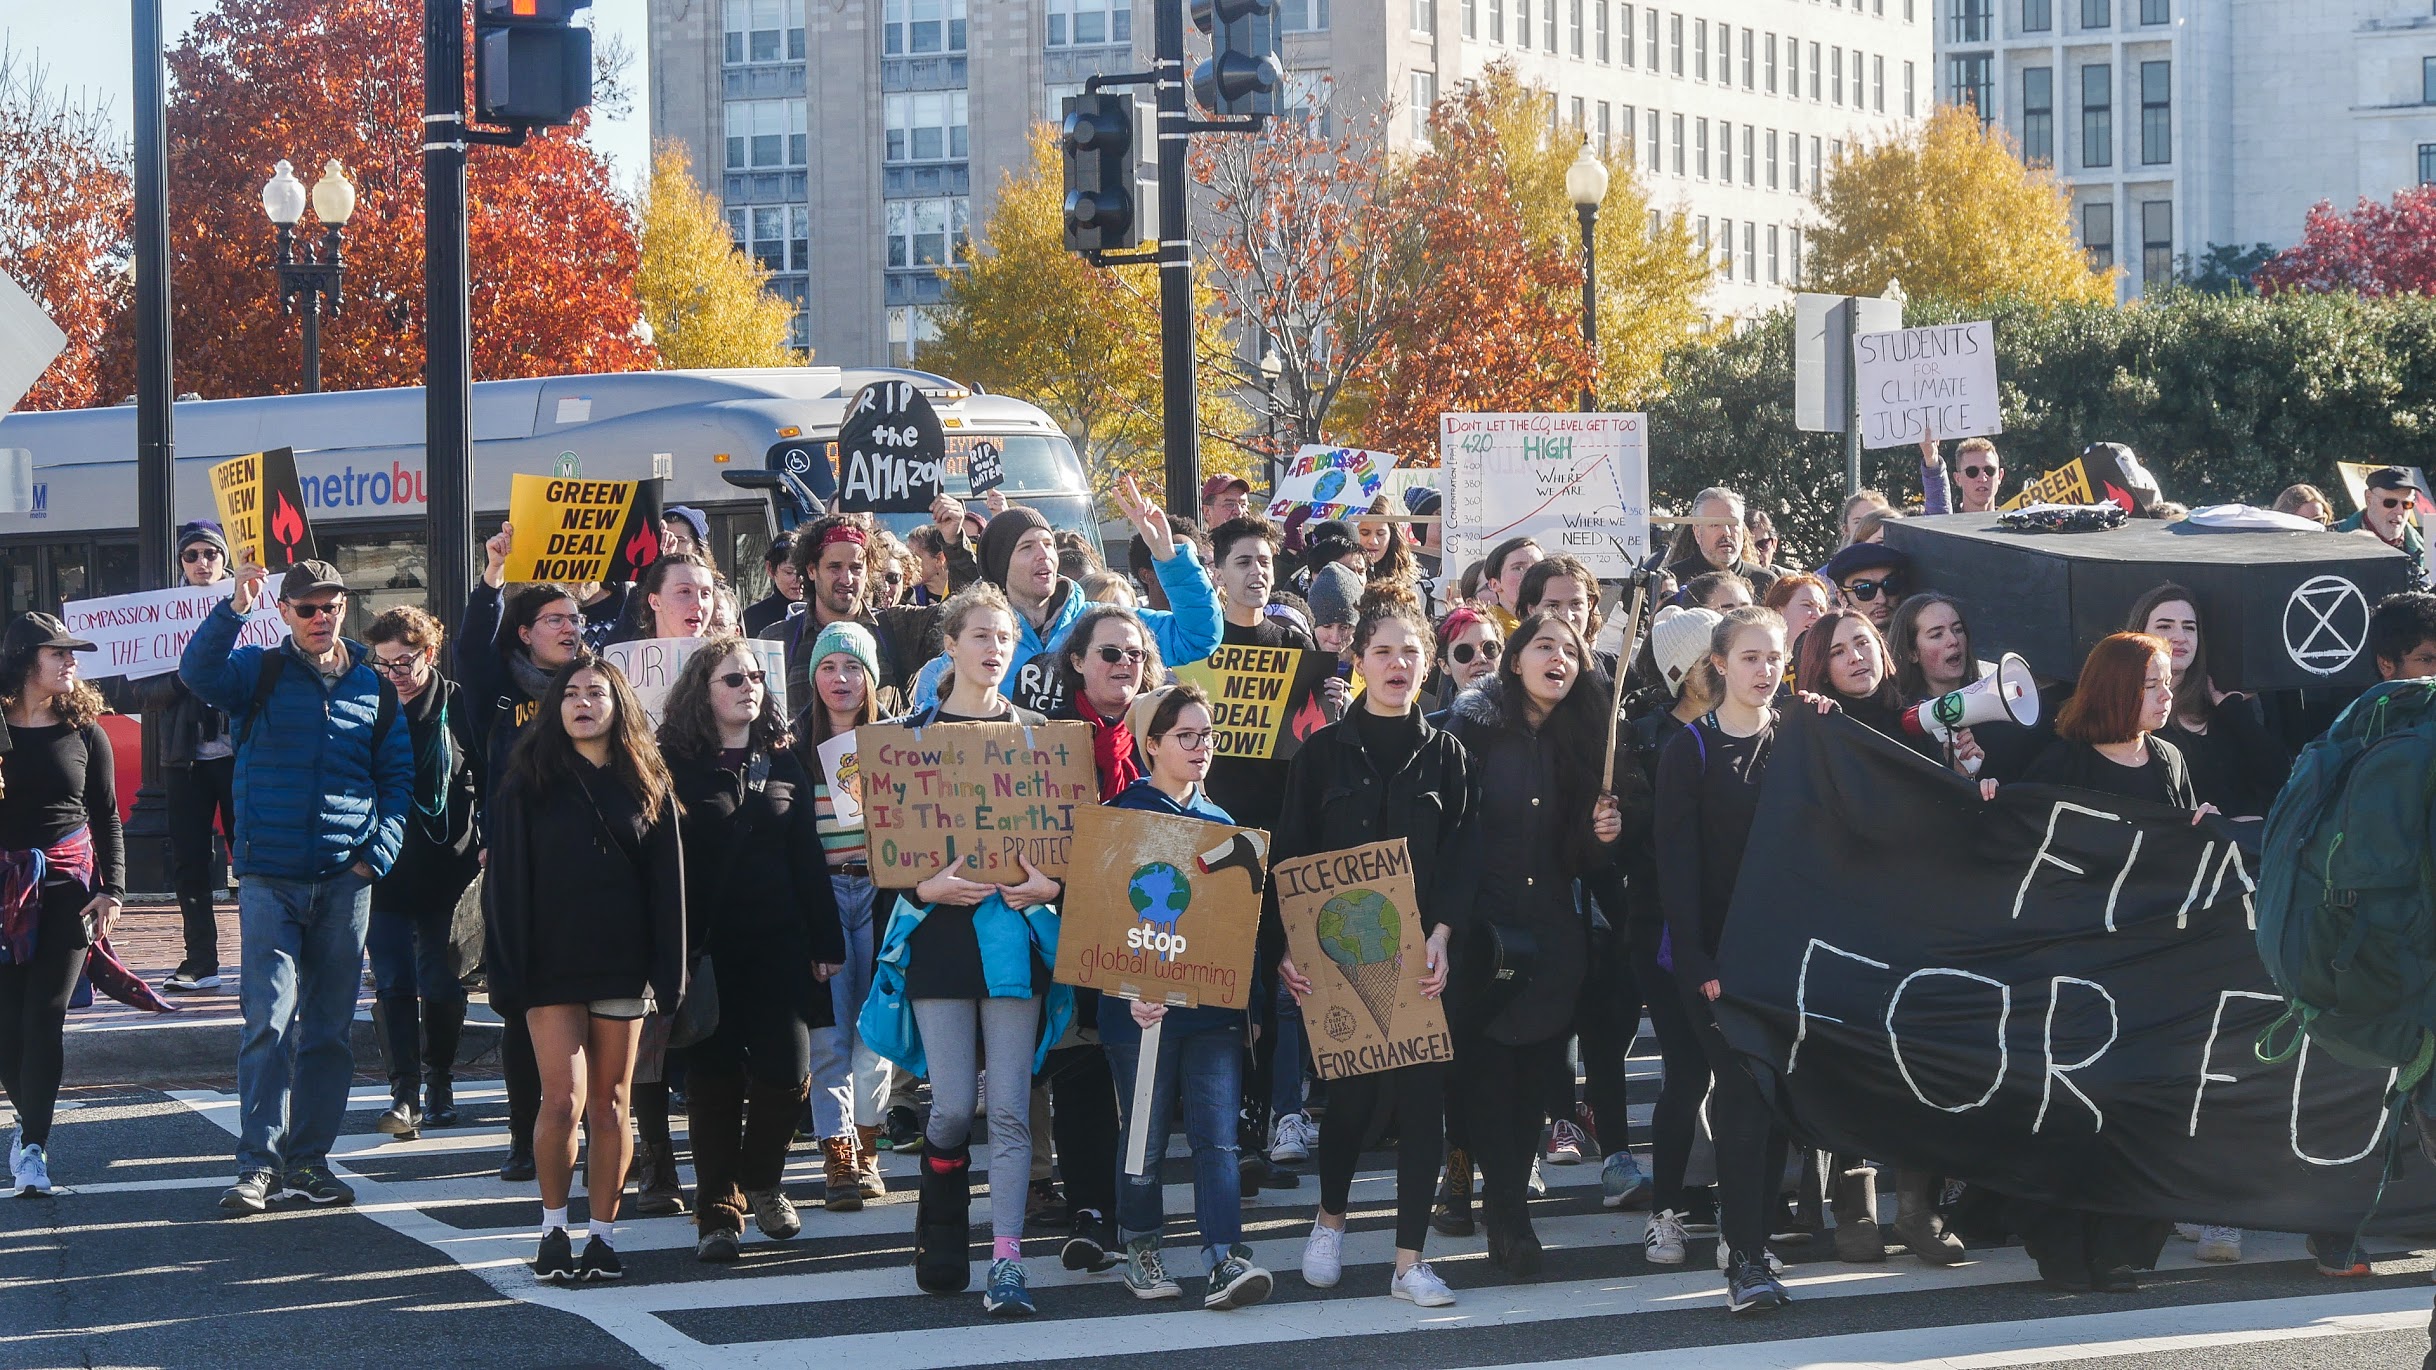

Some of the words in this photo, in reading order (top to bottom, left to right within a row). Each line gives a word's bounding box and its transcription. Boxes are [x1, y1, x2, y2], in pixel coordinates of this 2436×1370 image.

[1860, 326, 1979, 364] STUDENTS
[1913, 362, 1940, 377] FOR
[861, 382, 913, 414] RIP
[1881, 377, 1967, 404] CLIMATE
[1487, 420, 1506, 431] LET
[1509, 419, 1529, 431] THE
[1554, 419, 1583, 431] LEVEL
[1586, 419, 1608, 431] GET
[1612, 419, 1636, 431] TOO
[1873, 404, 1971, 441] JUSTICE
[872, 424, 918, 447] the
[1461, 433, 1493, 453] 420
[970, 443, 990, 463] RIP
[1523, 435, 1573, 461] HIGH
[218, 457, 255, 490] GREEN
[971, 464, 1003, 488] WATER
[1464, 480, 1480, 488] 380
[1536, 467, 1582, 483] WHERE
[546, 481, 628, 504] GREEN
[1536, 487, 1555, 496] WE
[1562, 485, 1585, 496] ARE
[2019, 465, 2079, 510] GREEN
[227, 486, 255, 516] NEW
[1464, 497, 1480, 506] 360
[1629, 507, 1645, 516] 350
[231, 516, 256, 545] DEAL
[561, 508, 621, 530] NEW
[1464, 515, 1480, 524] 340
[1562, 512, 1606, 528] WHERE
[1609, 517, 1626, 526] WE
[547, 534, 606, 555] DEAL
[1464, 532, 1480, 540] 320
[1562, 532, 1603, 546] NEED
[1628, 535, 1641, 546] BE
[1464, 548, 1480, 556] 300
[532, 559, 600, 580] NOW!
[67, 604, 160, 633] COMPASSION
[165, 598, 192, 621] CAN
[105, 637, 148, 666] THE
[1207, 648, 1290, 673] GREEN
[1224, 676, 1284, 699] NEW
[1214, 704, 1272, 728] DEAL
[879, 741, 965, 766] Crowds
[984, 740, 1069, 766] Aren't
[1214, 730, 1265, 755] OW!
[871, 772, 906, 804] My
[914, 769, 986, 806] Thing
[993, 770, 1086, 799] Neither
[912, 803, 966, 829] The
[882, 839, 939, 868] Ours
[1003, 836, 1072, 867] PROTEC
[1127, 923, 1187, 962] stop
[1079, 944, 1148, 983] global
[1155, 961, 1236, 1004] warming
[1788, 938, 2119, 1134] FOR
[2189, 990, 2399, 1166] FU
